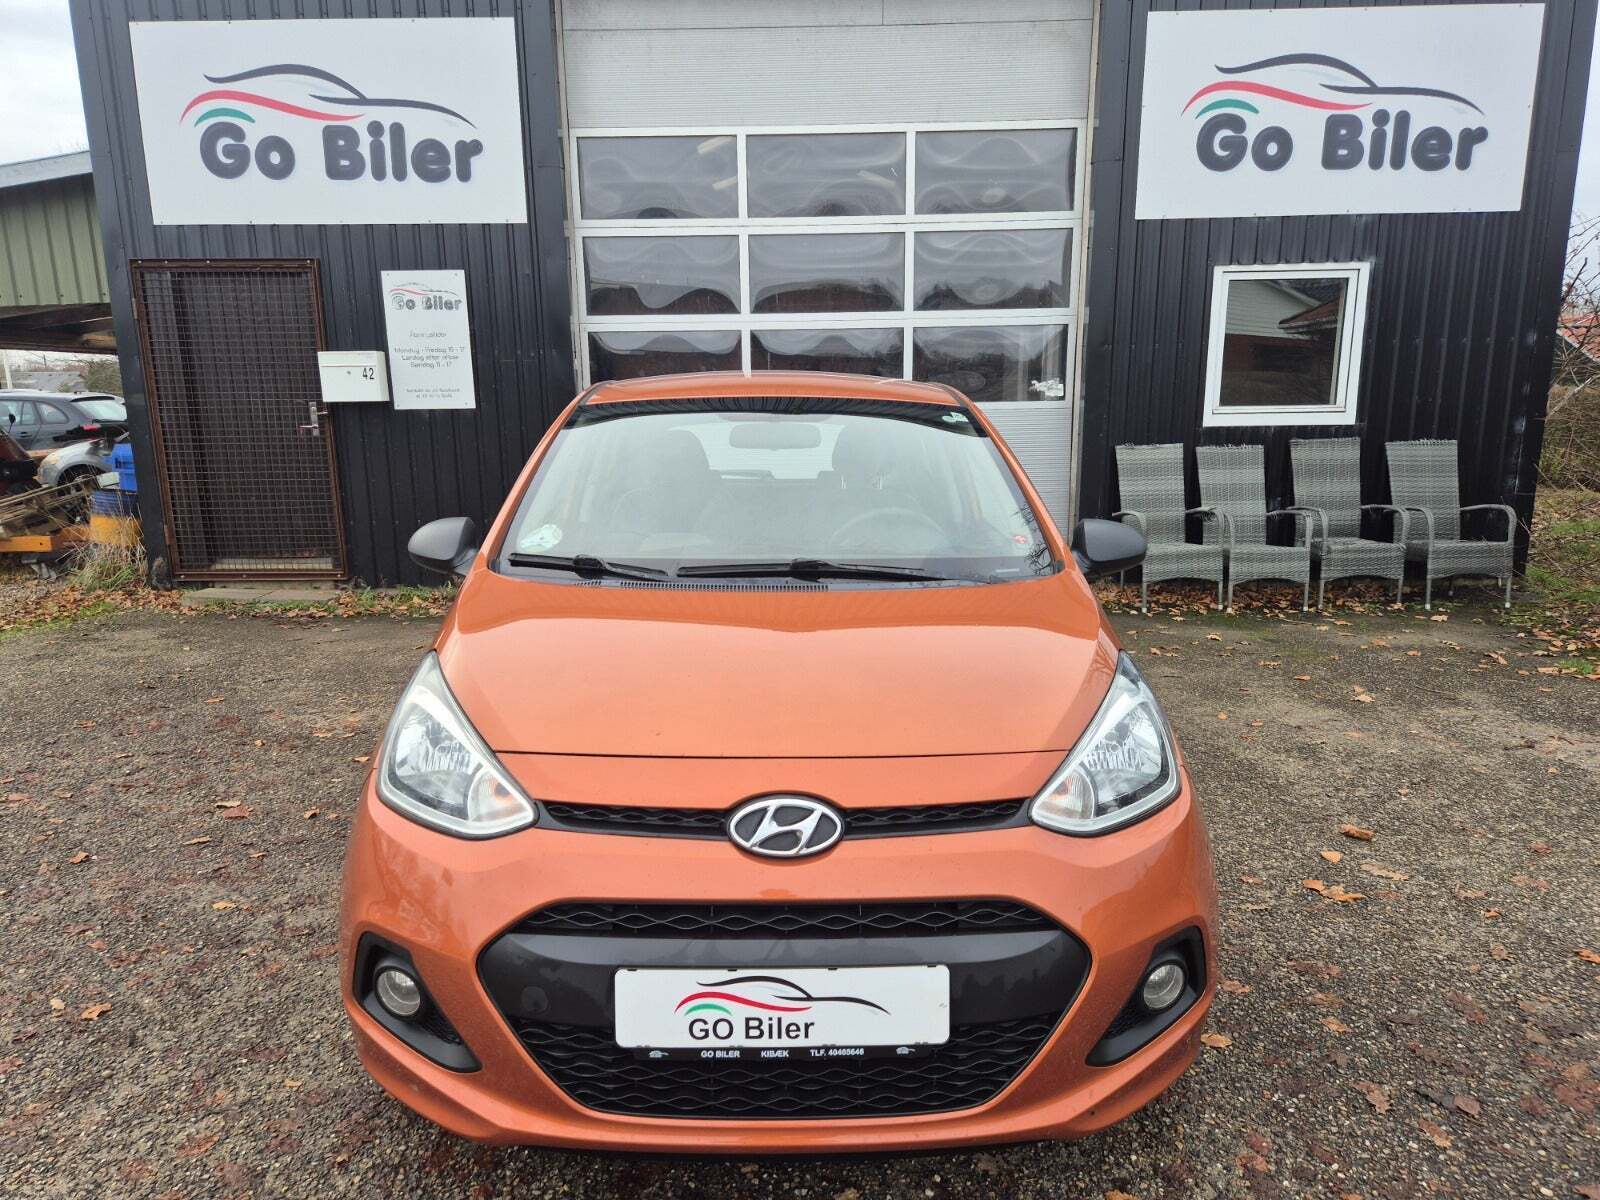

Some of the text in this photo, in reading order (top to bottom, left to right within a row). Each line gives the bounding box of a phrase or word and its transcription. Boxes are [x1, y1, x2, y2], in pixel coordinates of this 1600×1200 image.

[1196, 108, 1489, 172] Go Biler
[200, 120, 484, 183] Go Biler
[391, 295, 462, 310] Go Biler
[362, 367, 375, 380] 42
[688, 1016, 815, 1040] GO Biler
[700, 1050, 714, 1058] GO
[715, 1050, 741, 1058] BILER
[760, 1049, 789, 1058] KIBÆK
[810, 1049, 826, 1057] TLF.
